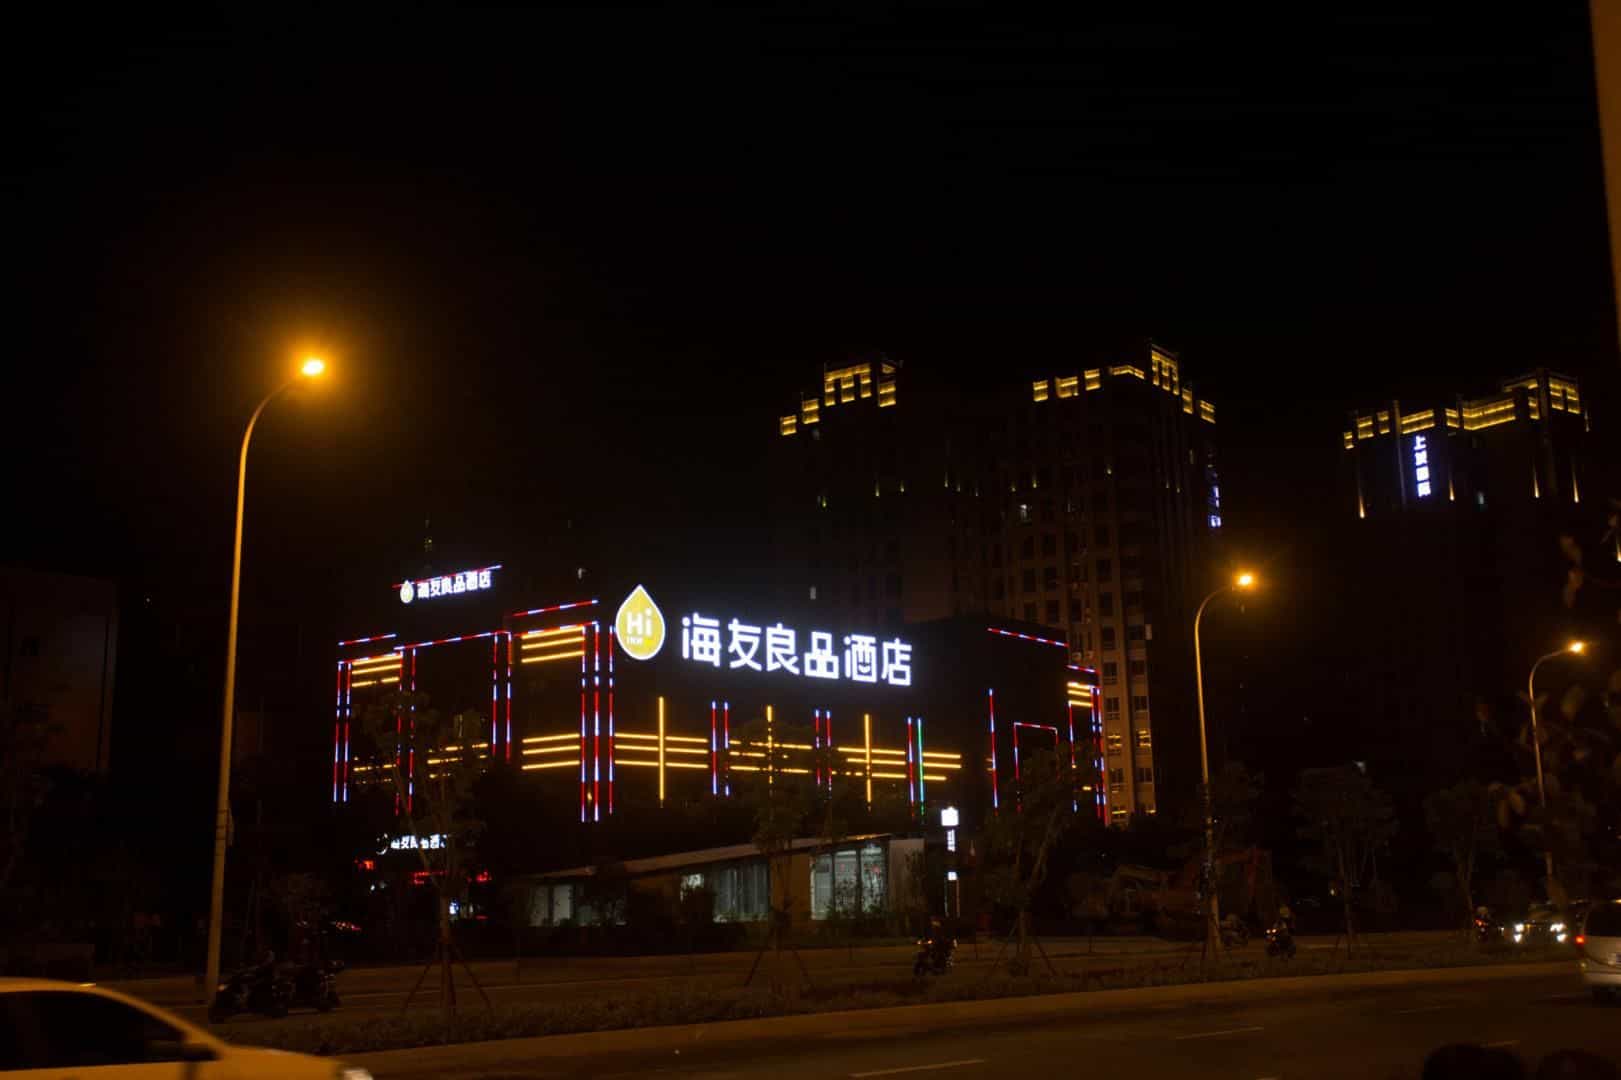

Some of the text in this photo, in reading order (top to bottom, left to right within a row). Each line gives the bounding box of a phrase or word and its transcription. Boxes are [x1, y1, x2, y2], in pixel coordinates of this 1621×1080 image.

[627, 608, 652, 636] Hi
[682, 611, 912, 687] 海友良品酒店
